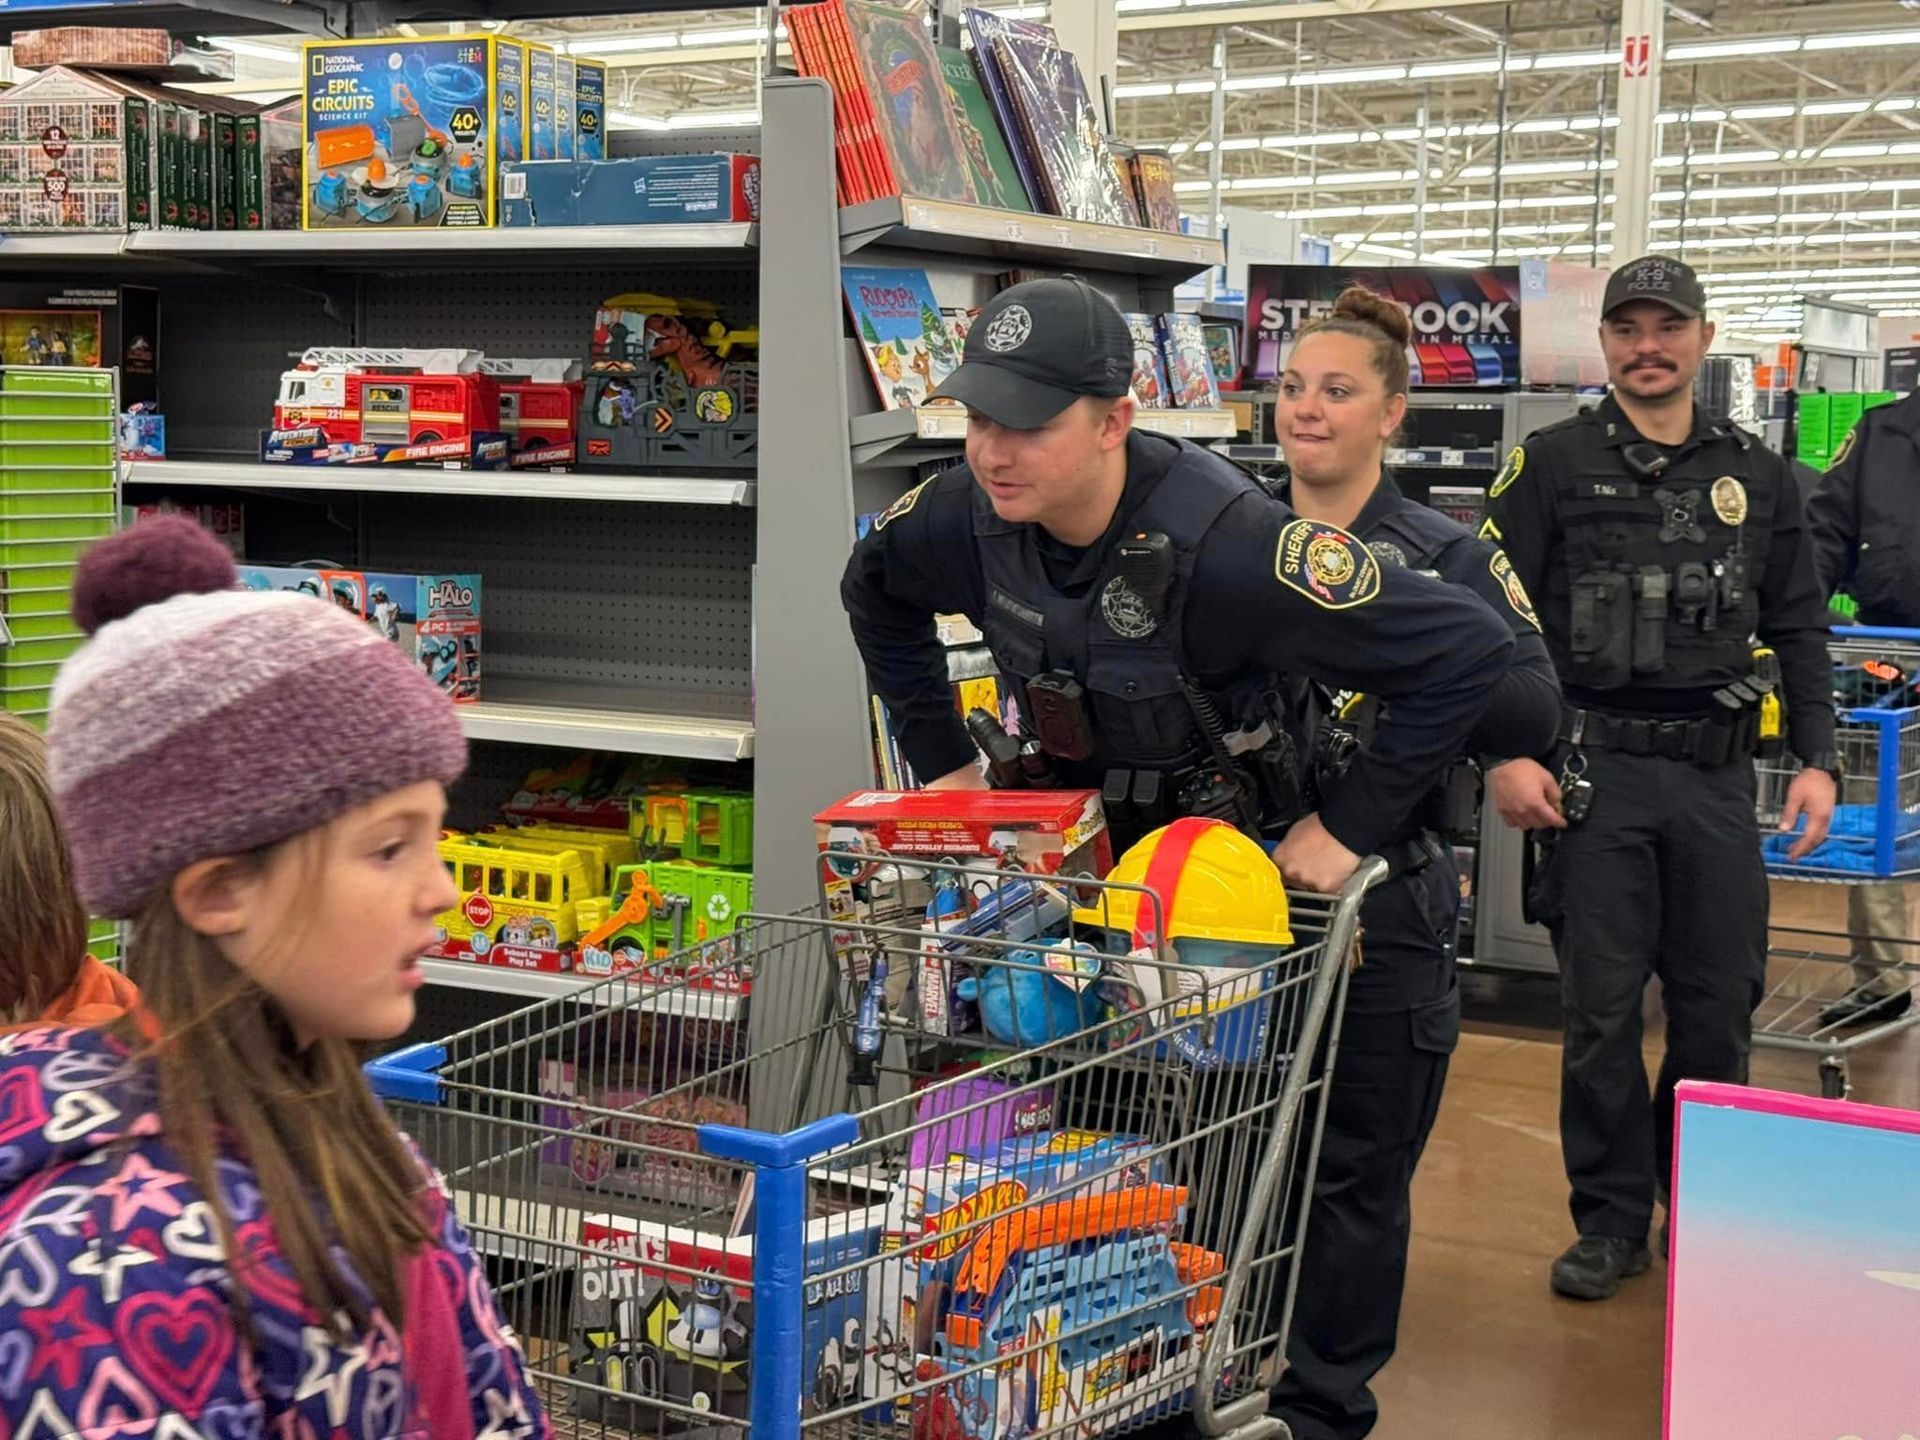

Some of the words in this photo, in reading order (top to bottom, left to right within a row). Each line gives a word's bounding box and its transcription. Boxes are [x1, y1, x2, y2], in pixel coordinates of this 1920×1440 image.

[325, 55, 356, 64] NATIONAL
[457, 51, 483, 64] STEM
[325, 63, 365, 74] GEOGRAPHIC
[328, 79, 358, 94] EPIC
[312, 96, 375, 113] CIRCUITS
[318, 113, 352, 122] SCIENCE
[354, 112, 368, 120] KIT
[452, 113, 480, 130] 40+
[50, 129, 60, 140] 12
[47, 181, 66, 193] 500
[1637, 268, 1665, 281] K-9
[1627, 280, 1673, 293] POLICE
[1420, 334, 1441, 345] IN
[1451, 333, 1513, 345] METAL
[371, 404, 401, 413] RESCUE
[405, 447, 428, 458] FIRE
[429, 442, 466, 455] ENGINE
[515, 454, 537, 464] FIRE
[538, 448, 571, 461] ENGINE
[1285, 522, 1314, 575] SHERIFF
[420, 621, 431, 634] 4
[431, 622, 444, 632] PC
[469, 905, 490, 915] STOP
[925, 972, 939, 1014] MARVEL
